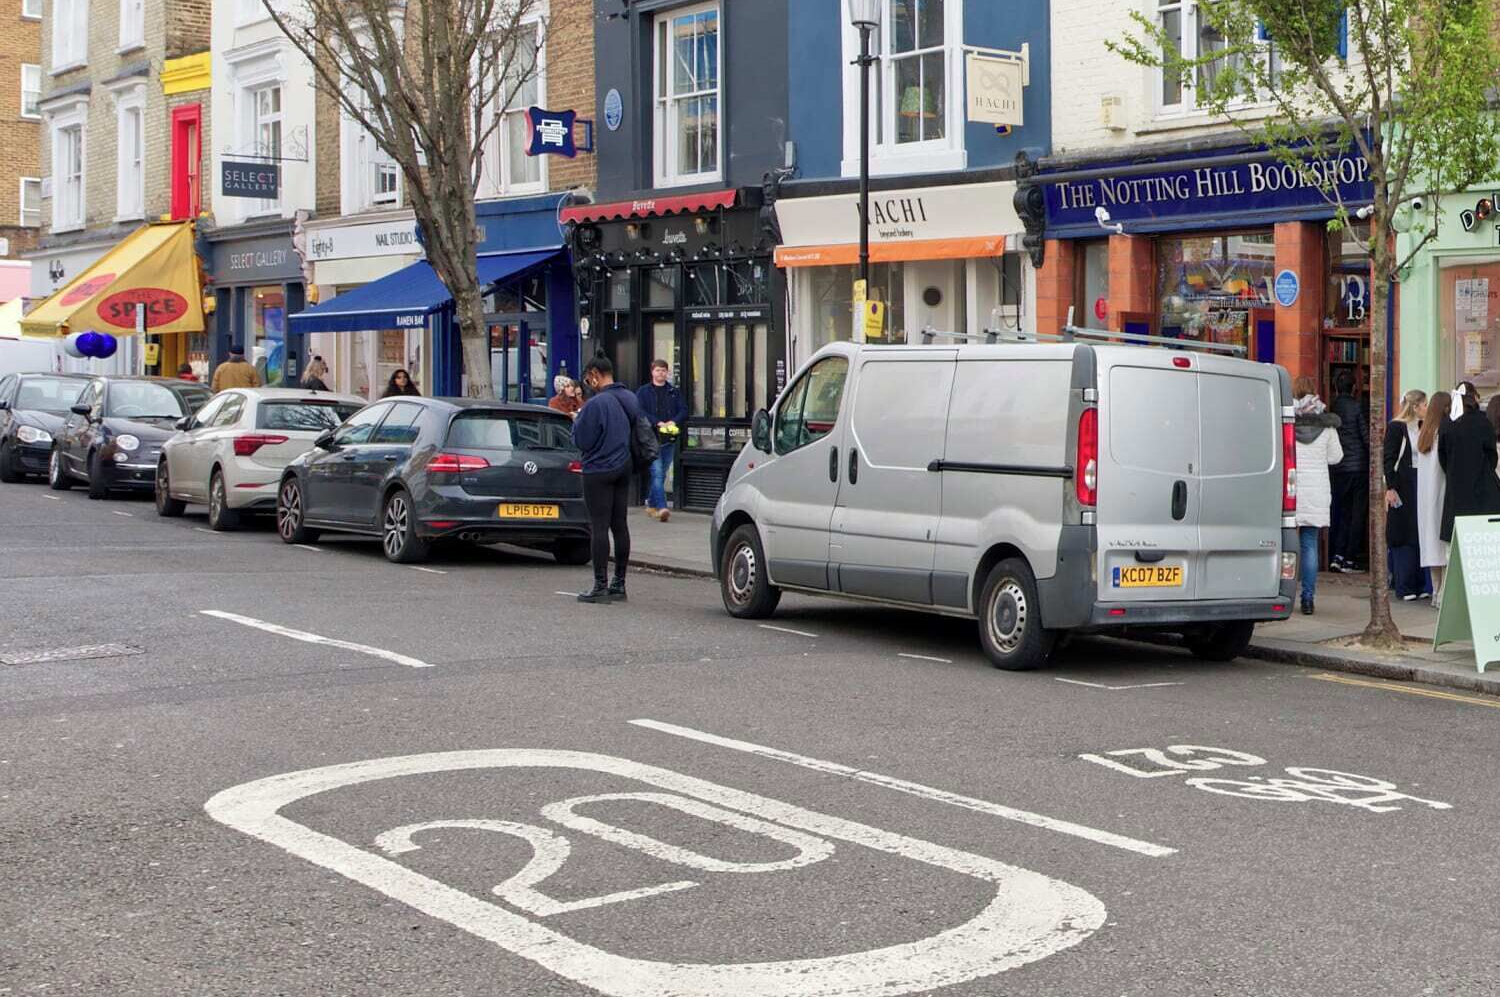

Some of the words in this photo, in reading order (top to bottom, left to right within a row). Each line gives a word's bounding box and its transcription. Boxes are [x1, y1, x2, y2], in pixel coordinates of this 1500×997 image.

[976, 97, 1015, 110] HACHI
[224, 170, 275, 182] SELECT
[1055, 181, 1096, 209] THE
[1099, 174, 1190, 206] NOTTING
[1194, 167, 1245, 198] HILL
[1248, 156, 1370, 194] BOOKSHOP
[224, 181, 276, 192] GALLERY
[375, 233, 389, 247] NAIL
[390, 230, 413, 246] STUDIO
[230, 253, 254, 269] SELECT
[255, 250, 287, 266] GALLERY
[109, 298, 177, 318] SPCE
[1346, 299, 1365, 320] 13
[396, 315, 414, 326] RAMEN
[414, 314, 424, 325] BAR
[506, 506, 530, 515] LP15
[1121, 567, 1154, 583] KC07
[1157, 567, 1181, 582] BZF
[374, 792, 836, 917] 20
